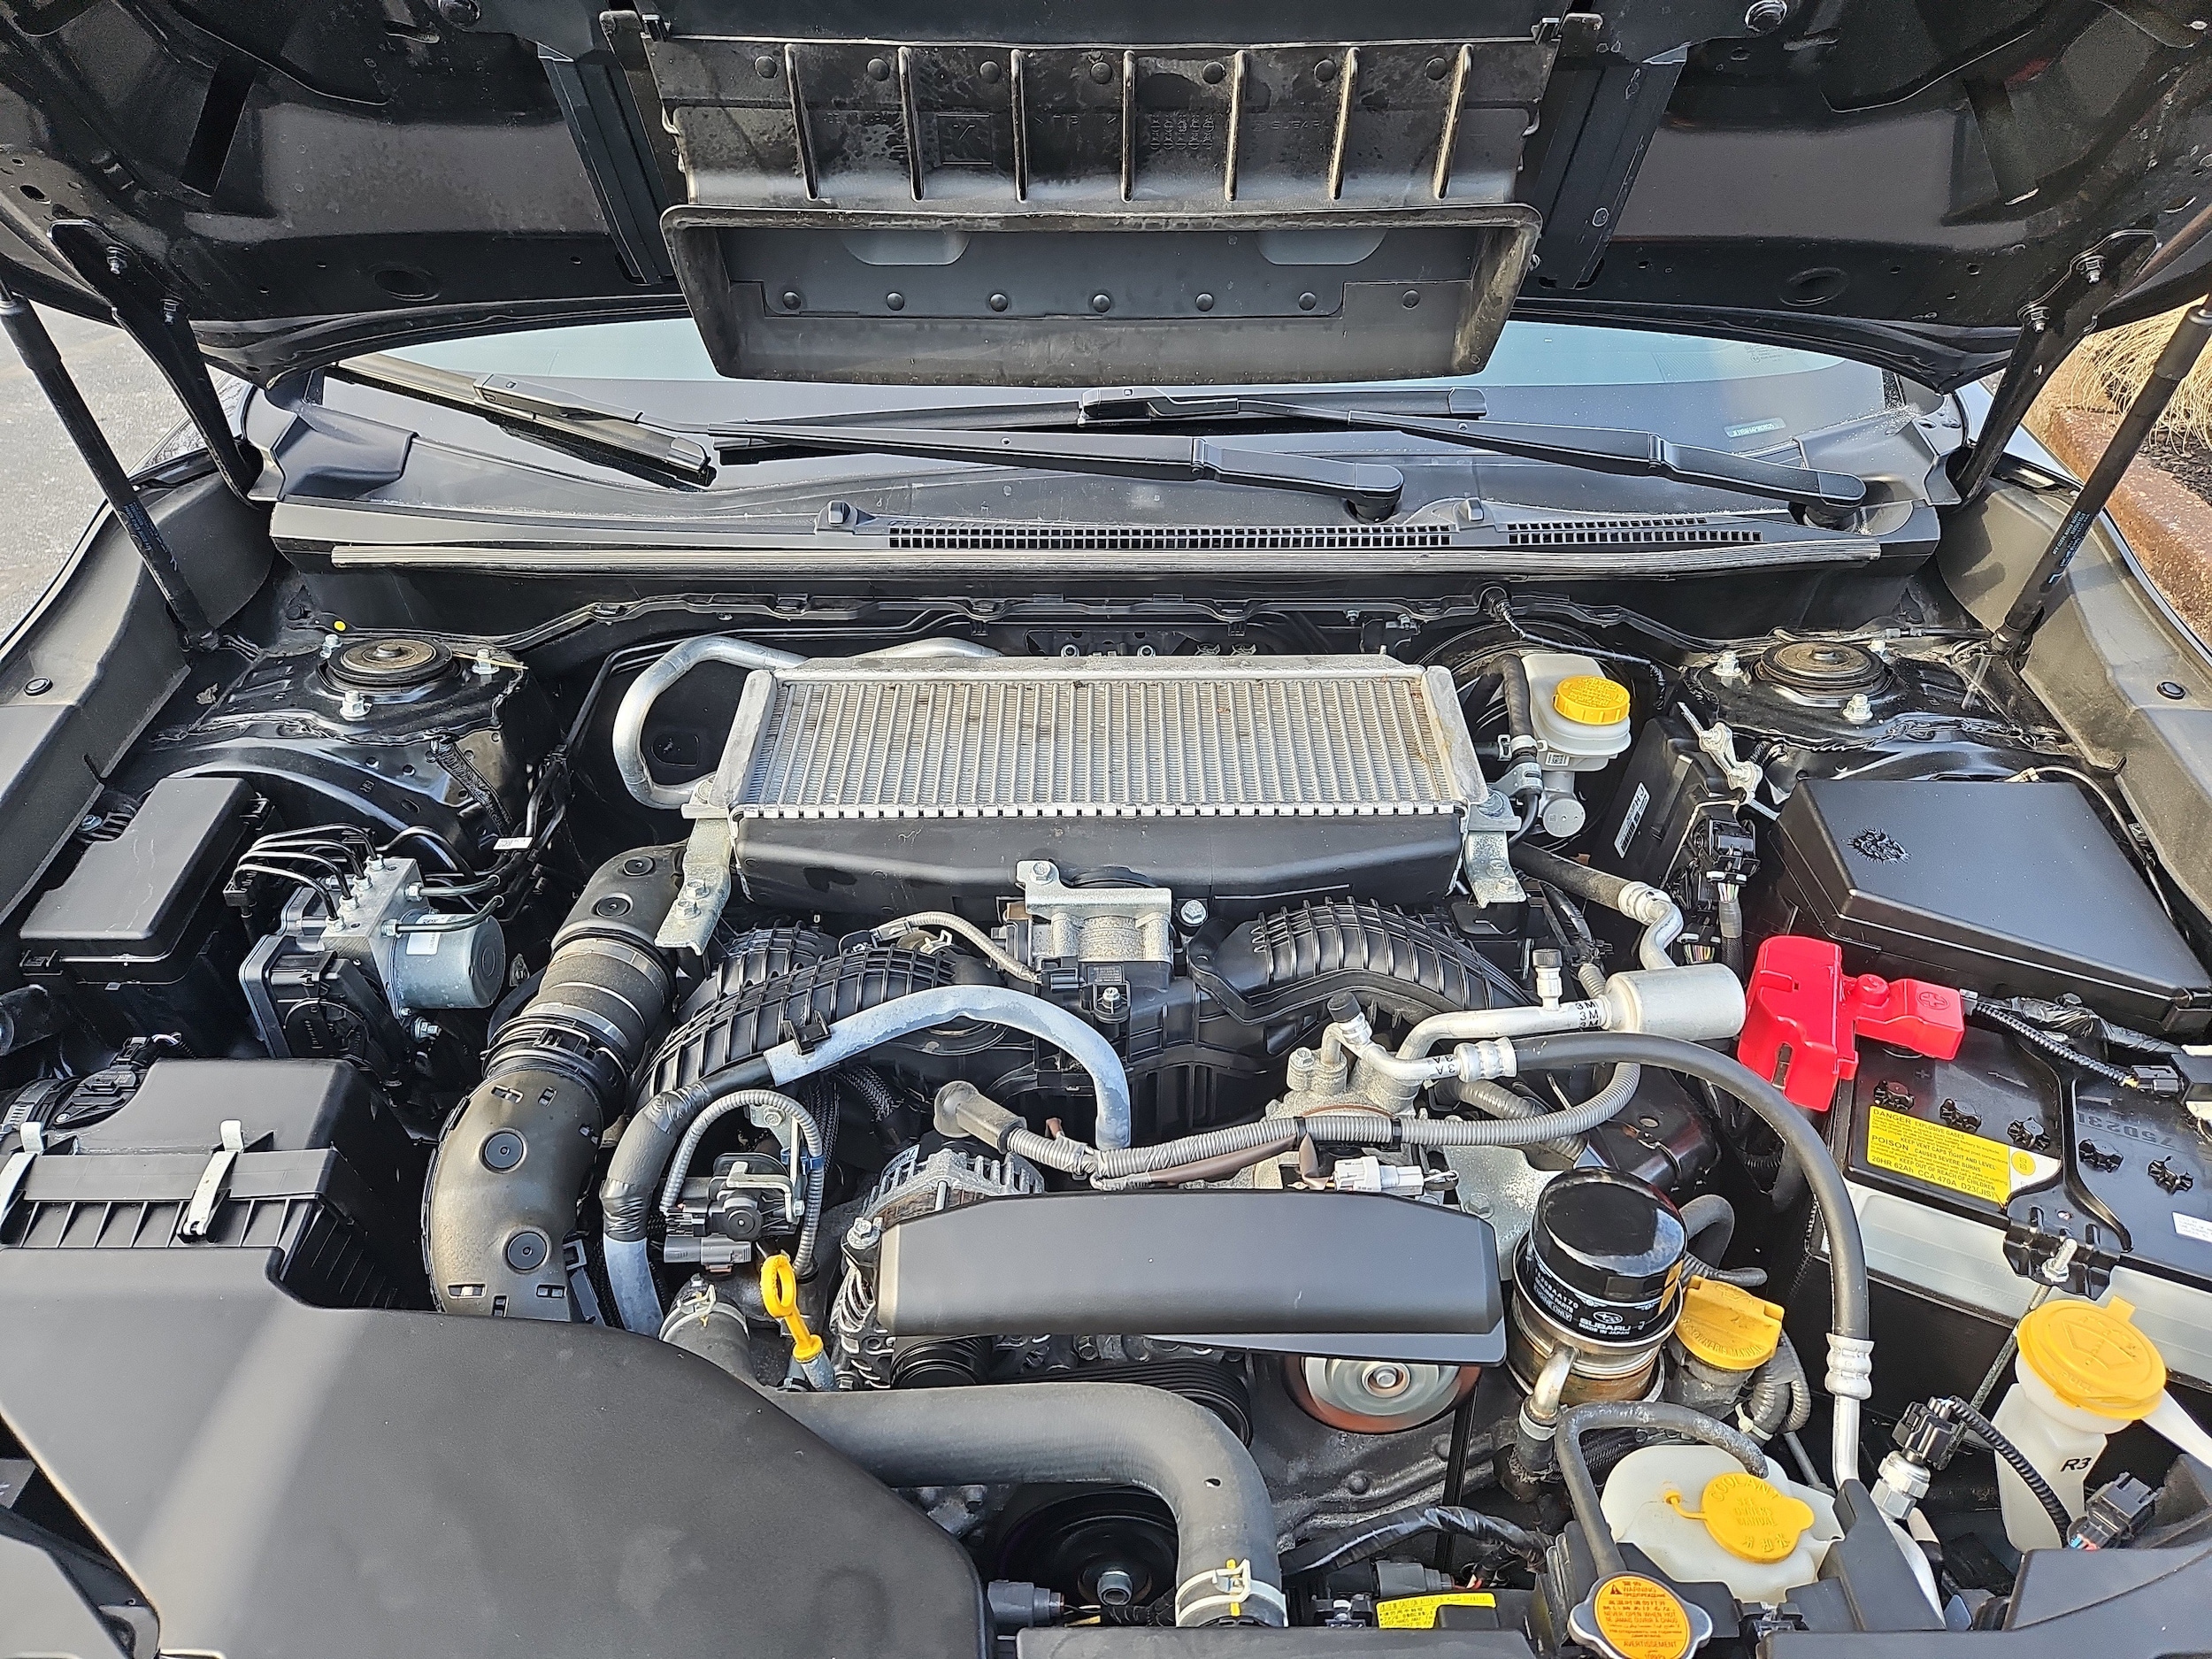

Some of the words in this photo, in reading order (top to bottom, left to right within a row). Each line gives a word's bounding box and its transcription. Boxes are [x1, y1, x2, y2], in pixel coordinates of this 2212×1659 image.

[1873, 1108, 1911, 1125] DANGER
[1914, 1120, 1944, 1133] EXPLOSIVE
[1946, 1129, 1964, 1140] GASES
[1871, 1133, 1909, 1150] POISON
[1914, 1147, 1937, 1159] CAUSES
[1938, 1154, 1961, 1166] SEVERE
[1961, 1161, 1981, 1172] BURNS
[1900, 1136, 1915, 1146] KEEP
[1916, 1141, 1930, 1150] VENT
[1931, 1145, 1947, 1155] CAPS
[1947, 1150, 1964, 1160] TIGHT
[1978, 1159, 1996, 1170] LEVEL
[1871, 1155, 1893, 1166] 20HR
[1893, 1161, 1914, 1173] 62Ah
[1917, 1169, 1936, 1180] CCA
[1937, 1174, 1956, 1187] 470A
[1961, 1181, 1994, 1198] D23(JIS)
[1899, 1156, 1914, 1166] KEEP
[1915, 1161, 1926, 1170] OUT
[1937, 1168, 1956, 1179] REACH
[1966, 1177, 1995, 1191] CHILDREN
[1554, 1297, 1574, 1313] PARTS
[1578, 1322, 1598, 1333] MADE
[1579, 1317, 1632, 1332] SUBARU
[1730, 1344, 1763, 1358] MANUAL
[2060, 1457, 2092, 1472] R3
[1709, 1475, 1782, 1502] COOLANT
[1737, 1517, 1777, 1527] MANUAL
